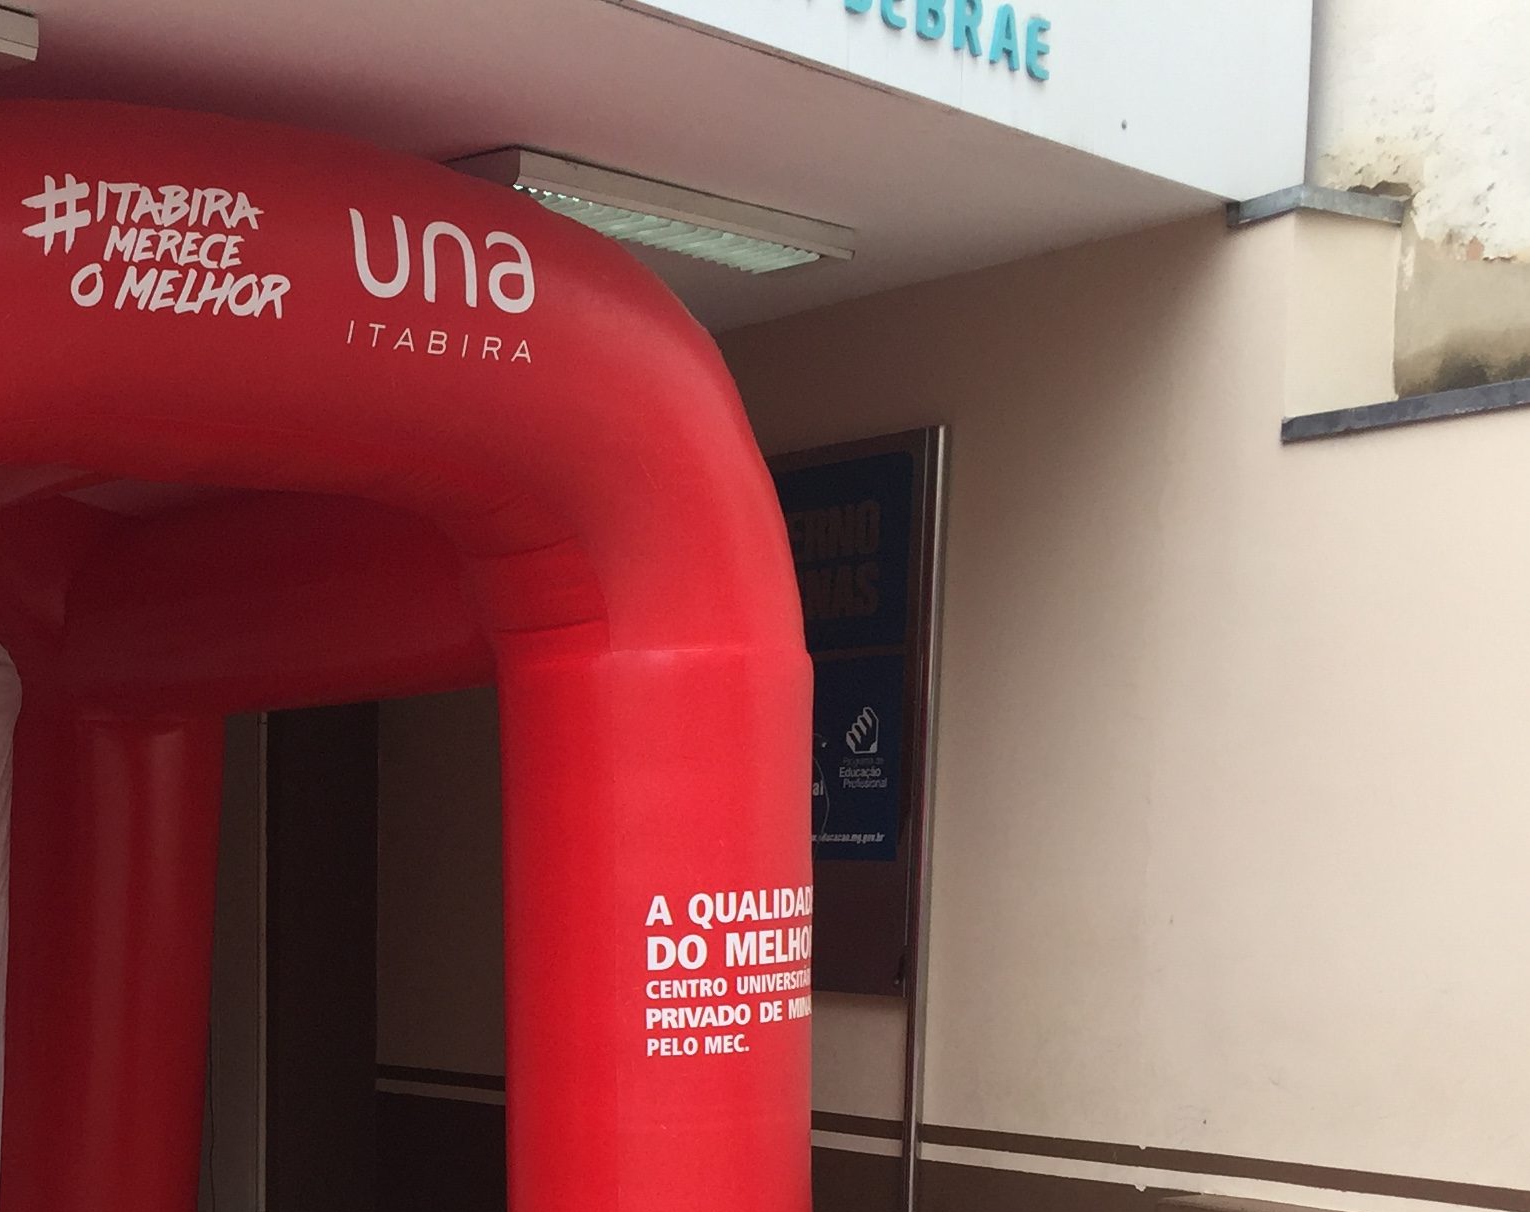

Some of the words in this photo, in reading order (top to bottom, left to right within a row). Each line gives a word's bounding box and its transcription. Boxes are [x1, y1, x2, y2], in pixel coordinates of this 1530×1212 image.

[103, 226, 245, 269] MERECE
[349, 207, 535, 313] una
[71, 264, 104, 307] O
[114, 266, 291, 319] MELHOR
[346, 320, 532, 364] ITABIRA
[645, 895, 673, 926] A
[687, 885, 813, 930] QUALIDAD
[647, 934, 707, 971] DO
[646, 977, 728, 999] CENTRO
[646, 1004, 751, 1030] PRIVADO
[759, 1001, 783, 1023] DE
[647, 1037, 699, 1056] PELO
[704, 1034, 749, 1055] MEC.
